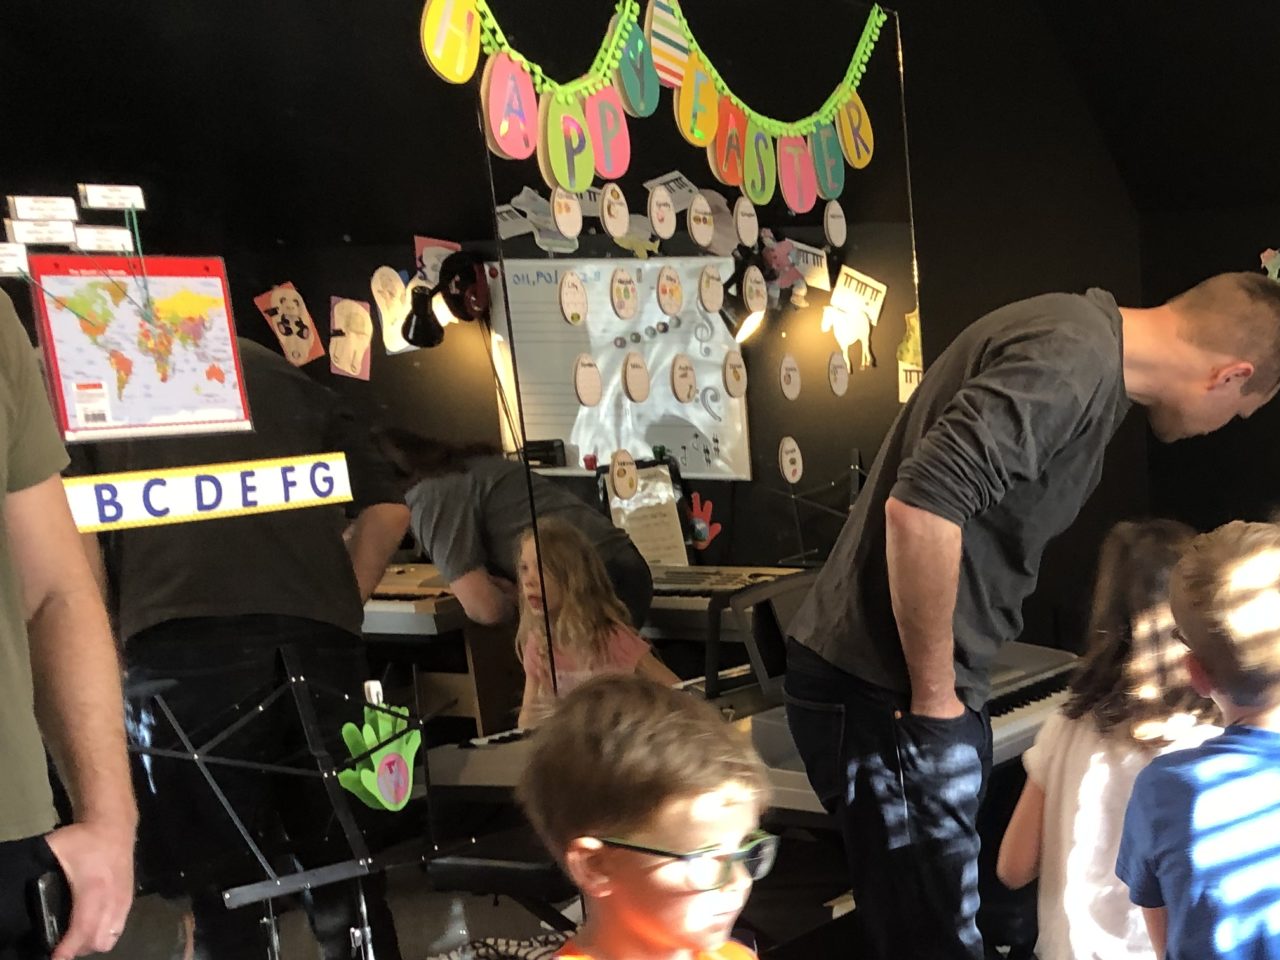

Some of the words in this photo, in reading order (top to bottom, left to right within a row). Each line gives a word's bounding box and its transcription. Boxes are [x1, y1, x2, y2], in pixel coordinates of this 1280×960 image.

[432, 0, 645, 189] HAPPY
[690, 70, 871, 209] EASTER
[94, 483, 123, 523] B
[142, 478, 170, 517] C
[195, 474, 223, 512] D
[240, 470, 258, 507] E
[281, 465, 297, 503] F
[310, 461, 334, 498] G
